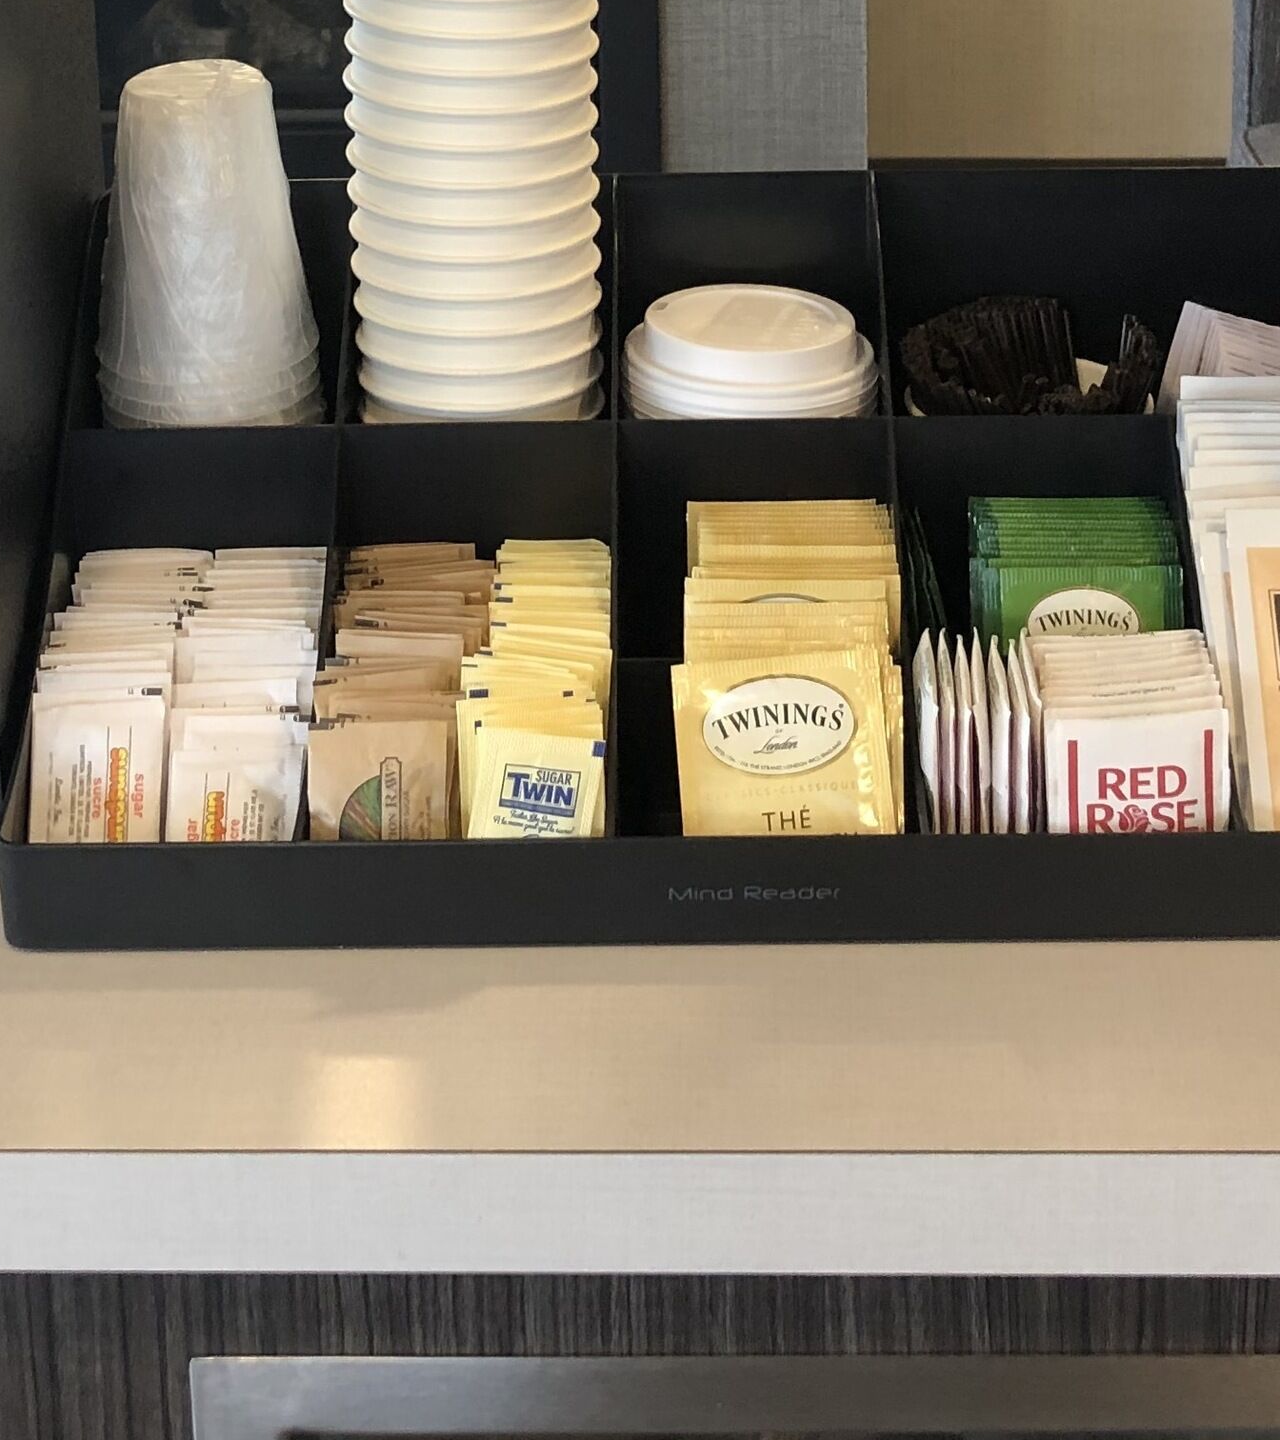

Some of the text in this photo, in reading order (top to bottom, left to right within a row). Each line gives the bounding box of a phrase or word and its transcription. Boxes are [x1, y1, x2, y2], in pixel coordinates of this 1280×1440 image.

[1035, 608, 1132, 632] TWININGS
[711, 702, 845, 740] TWININGS
[753, 735, 799, 754] London
[384, 770, 397, 809] RAW
[507, 771, 574, 806] TWIN
[535, 769, 573, 786] SUGAR
[1097, 764, 1187, 801] RED
[92, 777, 102, 819] sucre
[131, 773, 145, 818] sugar
[186, 818, 200, 842] gar
[230, 818, 240, 841] cre
[761, 804, 812, 832] THÉ
[668, 884, 842, 901] Mind Reader
